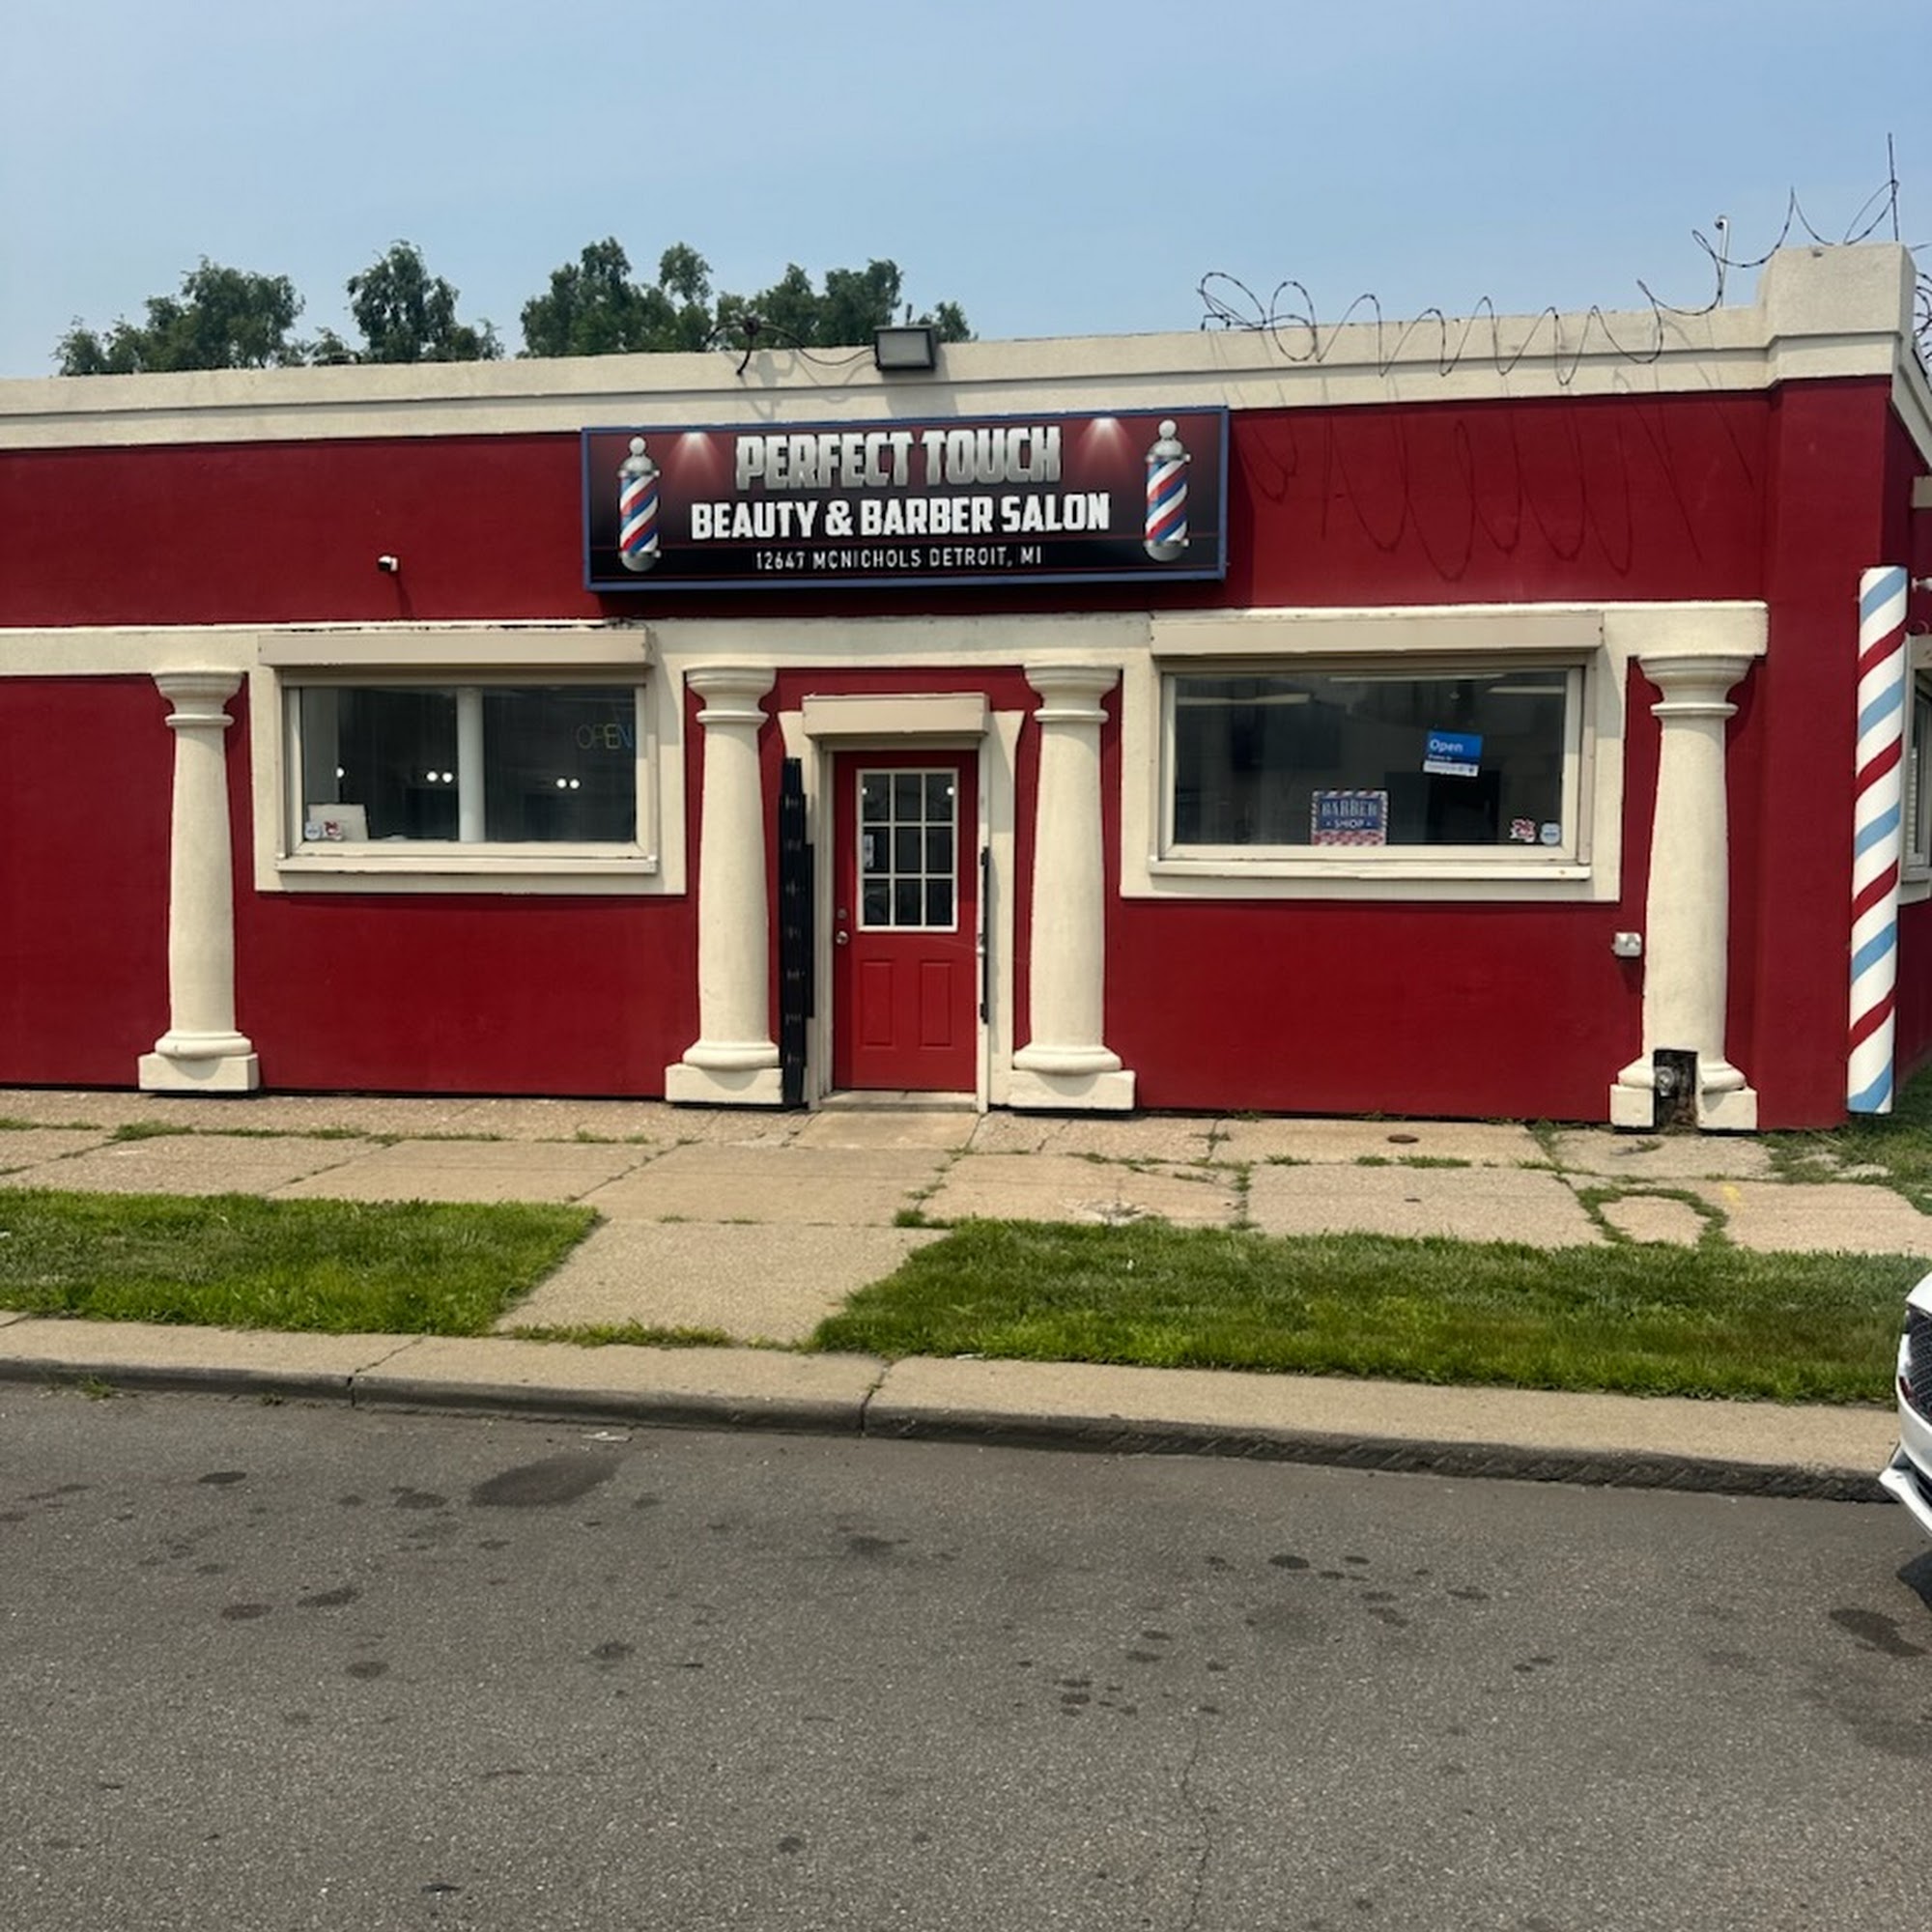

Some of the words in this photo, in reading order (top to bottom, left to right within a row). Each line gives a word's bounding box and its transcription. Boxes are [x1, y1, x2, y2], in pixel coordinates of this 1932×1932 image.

[735, 431, 914, 491] PERFECT
[921, 426, 1062, 486] TOUCH
[691, 500, 818, 540] BEAUTY
[825, 499, 853, 536] &
[860, 495, 993, 536] BARBER
[1000, 492, 1110, 532] SALON
[812, 548, 922, 570] MCNICHOLS
[929, 546, 1013, 567] DETROIT,
[1020, 545, 1041, 565] MI
[577, 724, 634, 750] OPEN
[1430, 738, 1463, 753] Open
[1321, 800, 1378, 817] BARBER
[1334, 818, 1365, 829] SHOP
